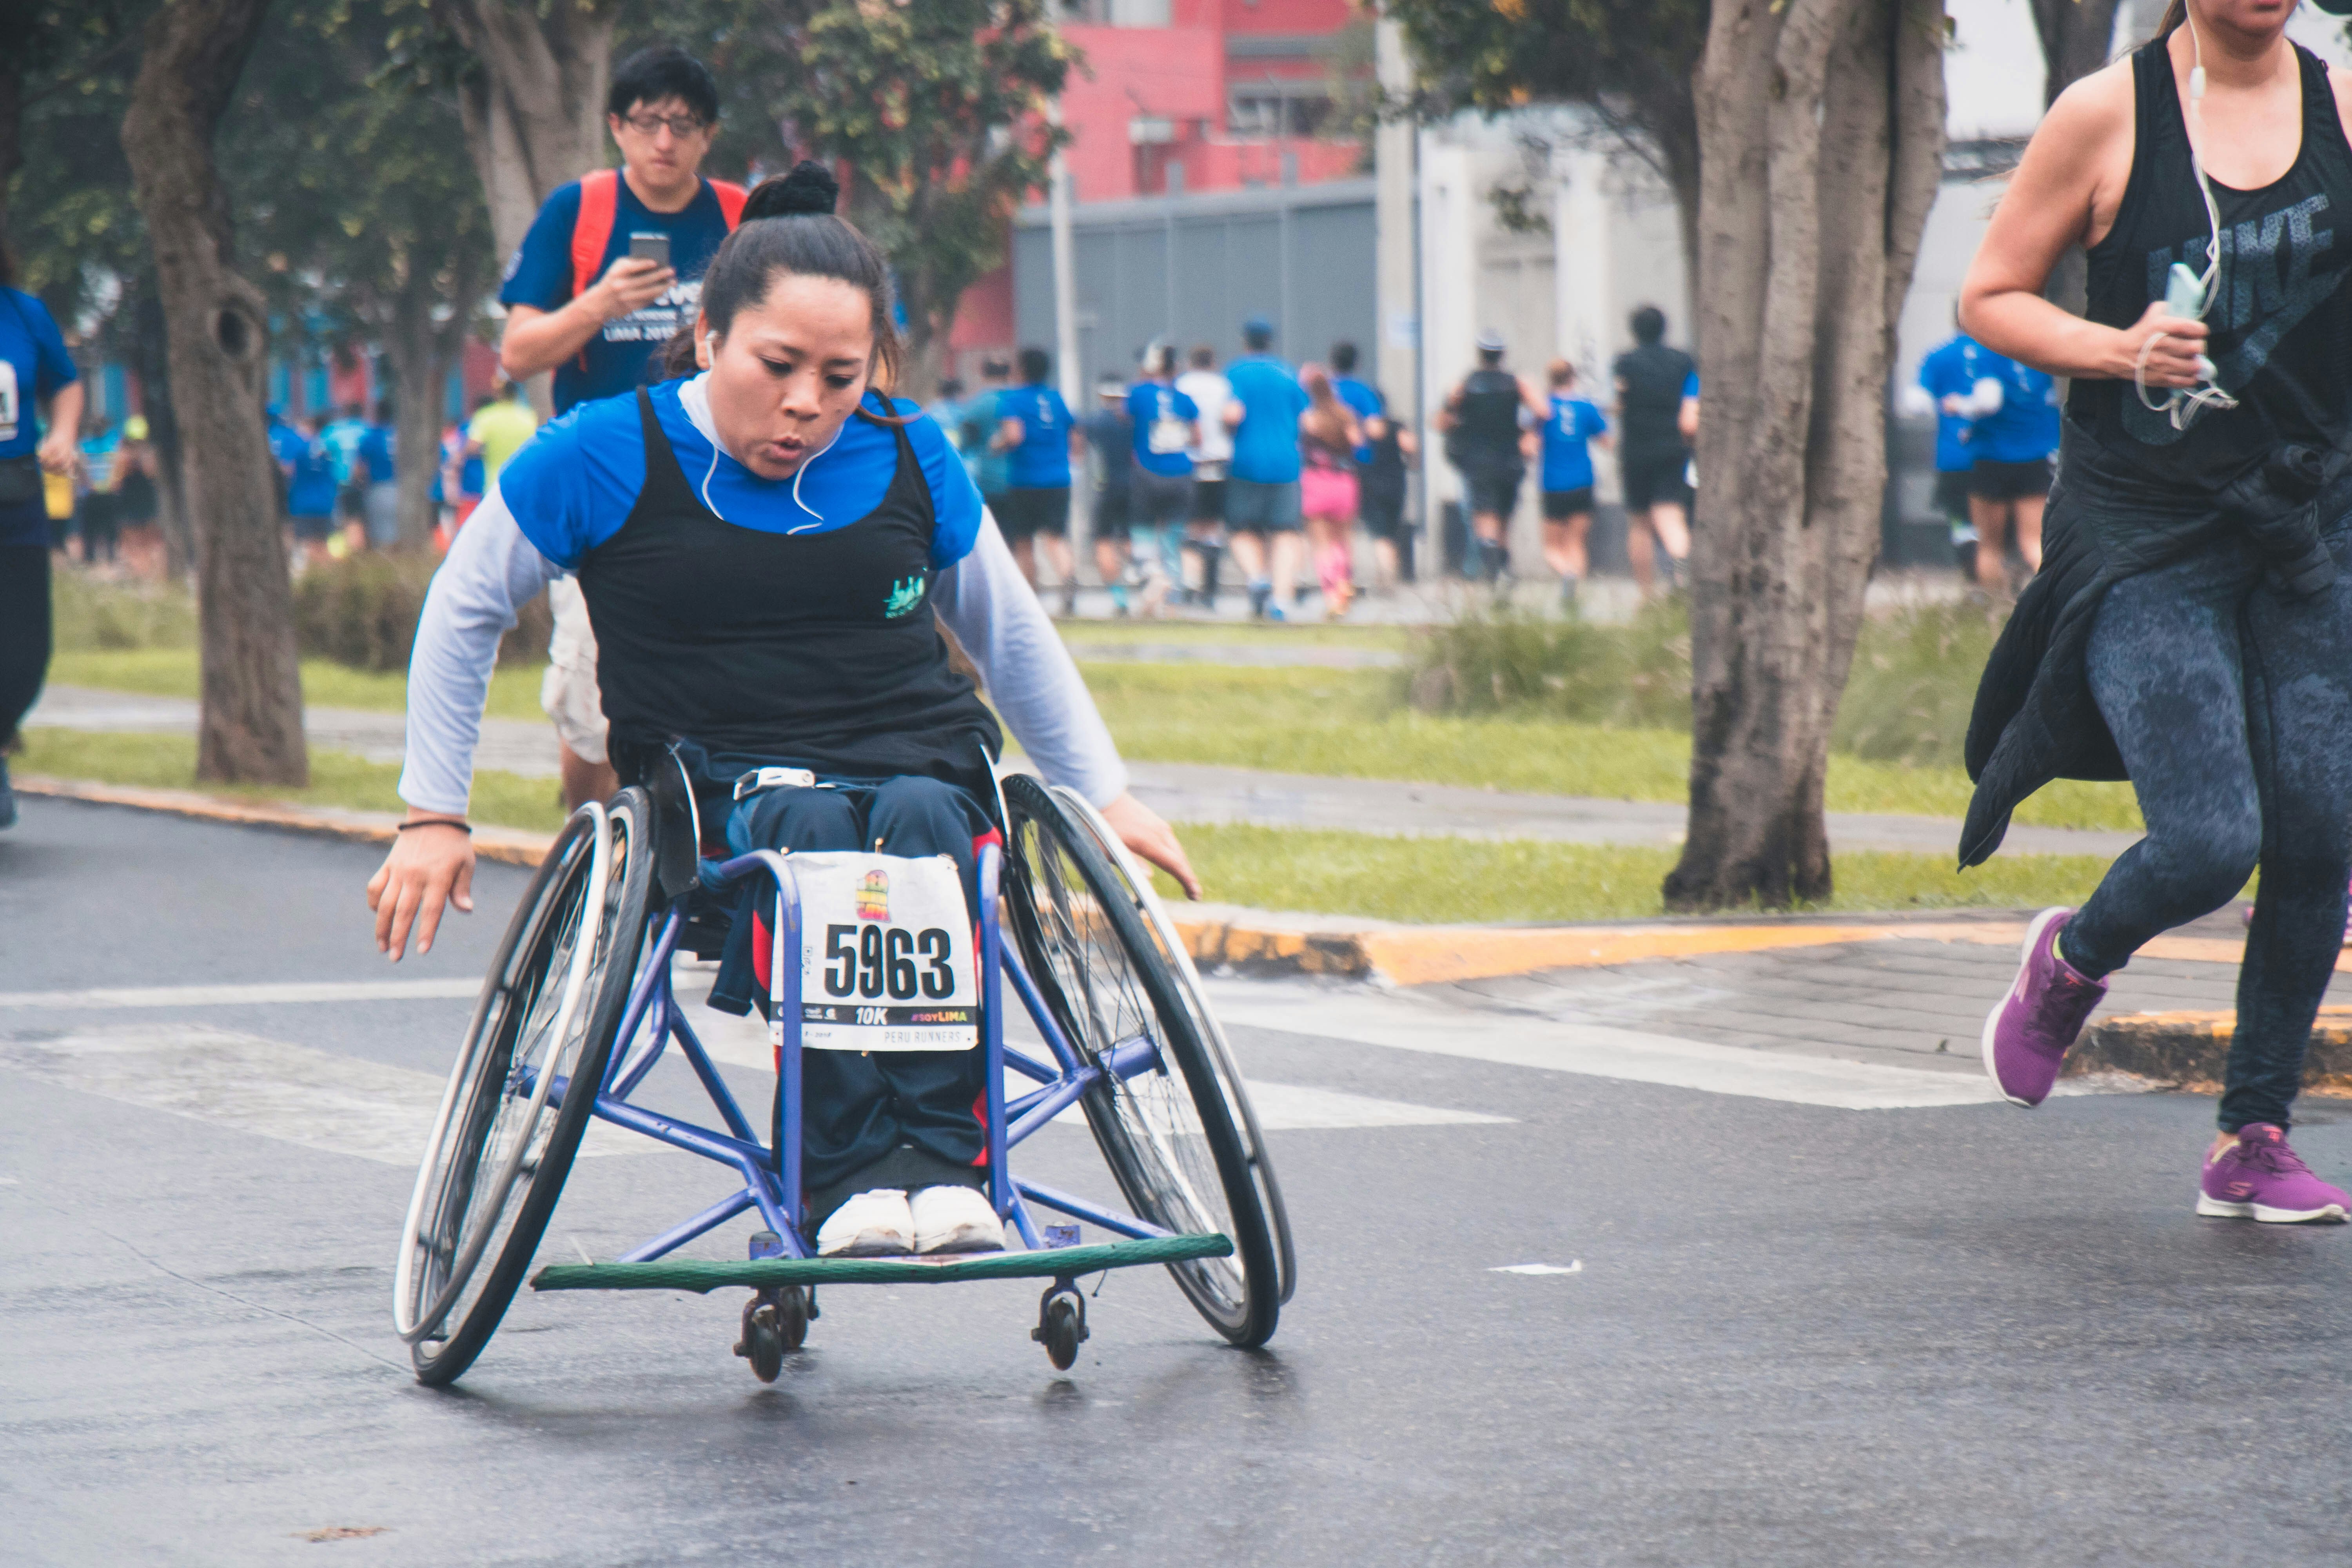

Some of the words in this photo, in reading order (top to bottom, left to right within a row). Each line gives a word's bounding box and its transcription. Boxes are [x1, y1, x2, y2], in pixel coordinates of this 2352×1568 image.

[824, 924, 955, 1001] 5963
[855, 1006, 888, 1025] 10K
[911, 1011, 967, 1022] #SOYLIMA
[884, 1031, 910, 1044] PERU
[914, 1031, 960, 1044] RUNNERS
